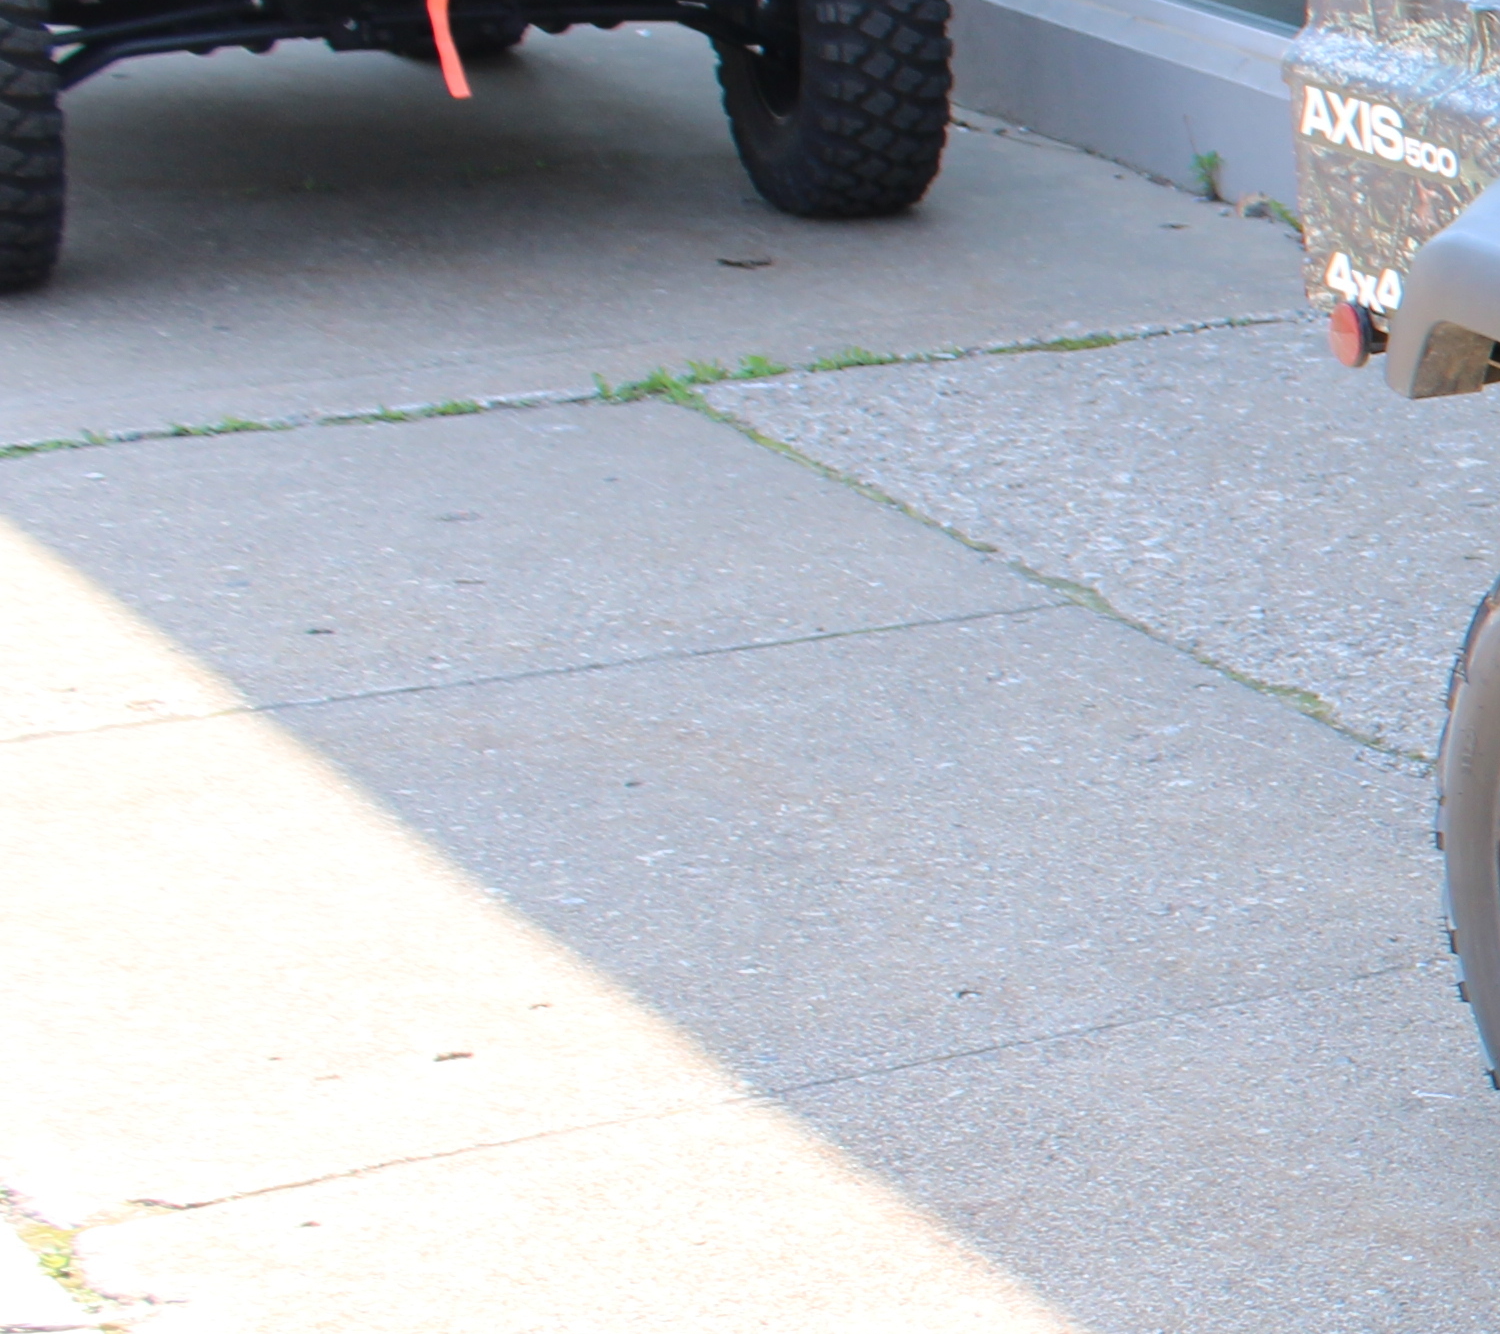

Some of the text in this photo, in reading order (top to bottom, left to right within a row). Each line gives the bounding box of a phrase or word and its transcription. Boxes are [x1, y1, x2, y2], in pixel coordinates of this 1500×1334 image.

[1300, 85, 1458, 178] AXIS 500
[1325, 252, 1403, 314] 4x4
